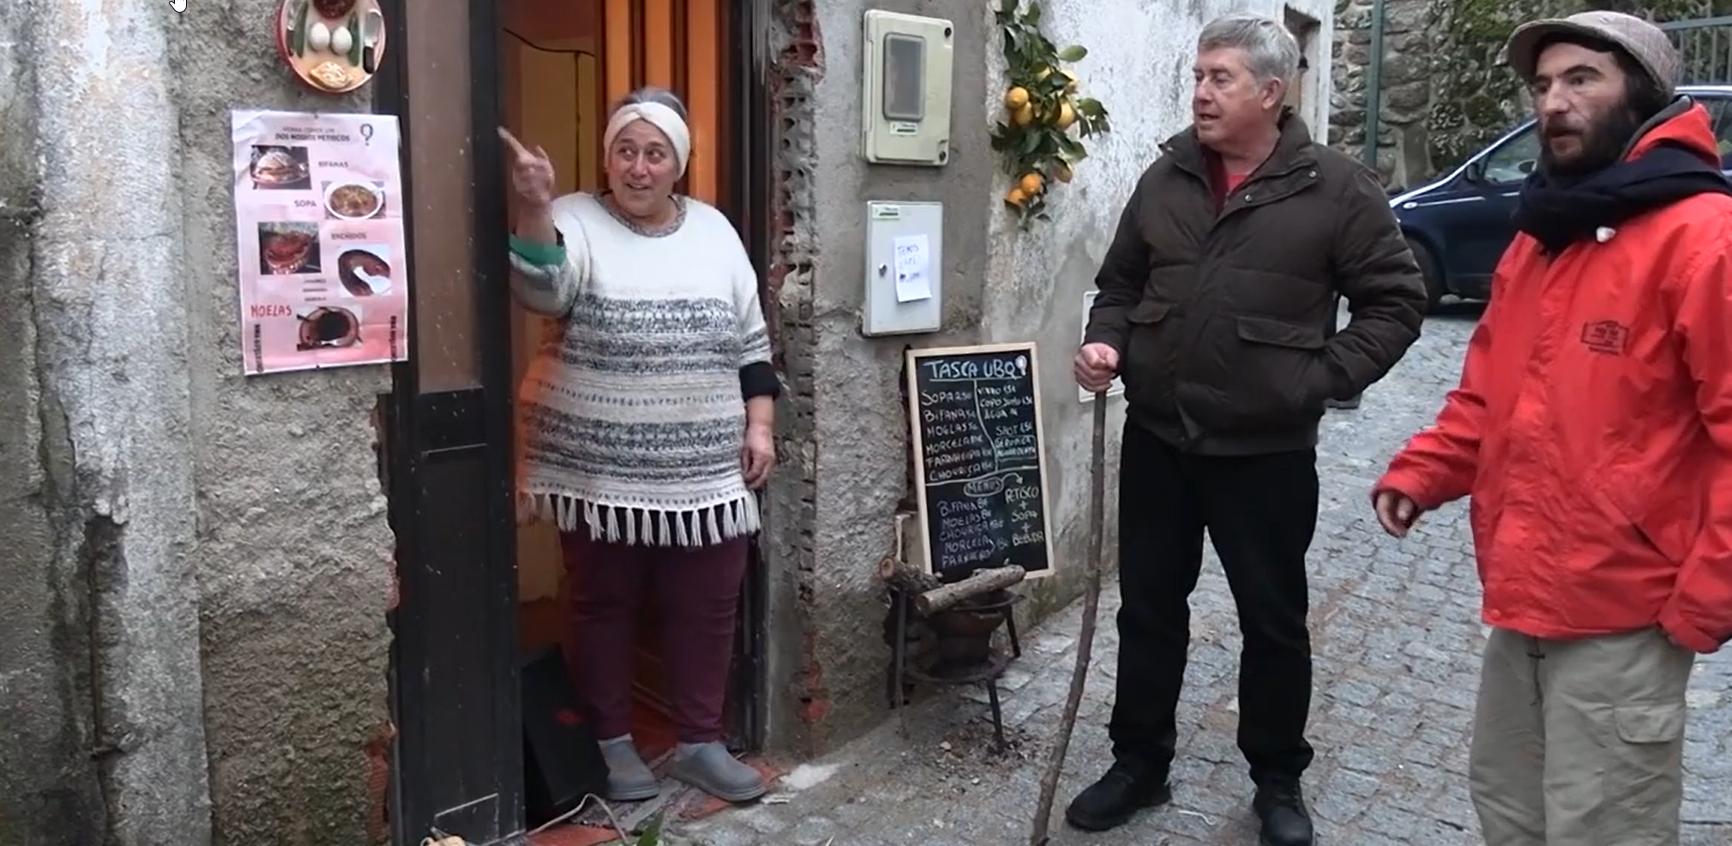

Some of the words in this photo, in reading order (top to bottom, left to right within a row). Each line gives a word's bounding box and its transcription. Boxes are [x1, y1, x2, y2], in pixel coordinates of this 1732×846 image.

[294, 199, 317, 208] SOPA
[250, 304, 293, 317] MOELAS
[923, 360, 978, 379] TASCA
[926, 423, 967, 438] MOELAS
